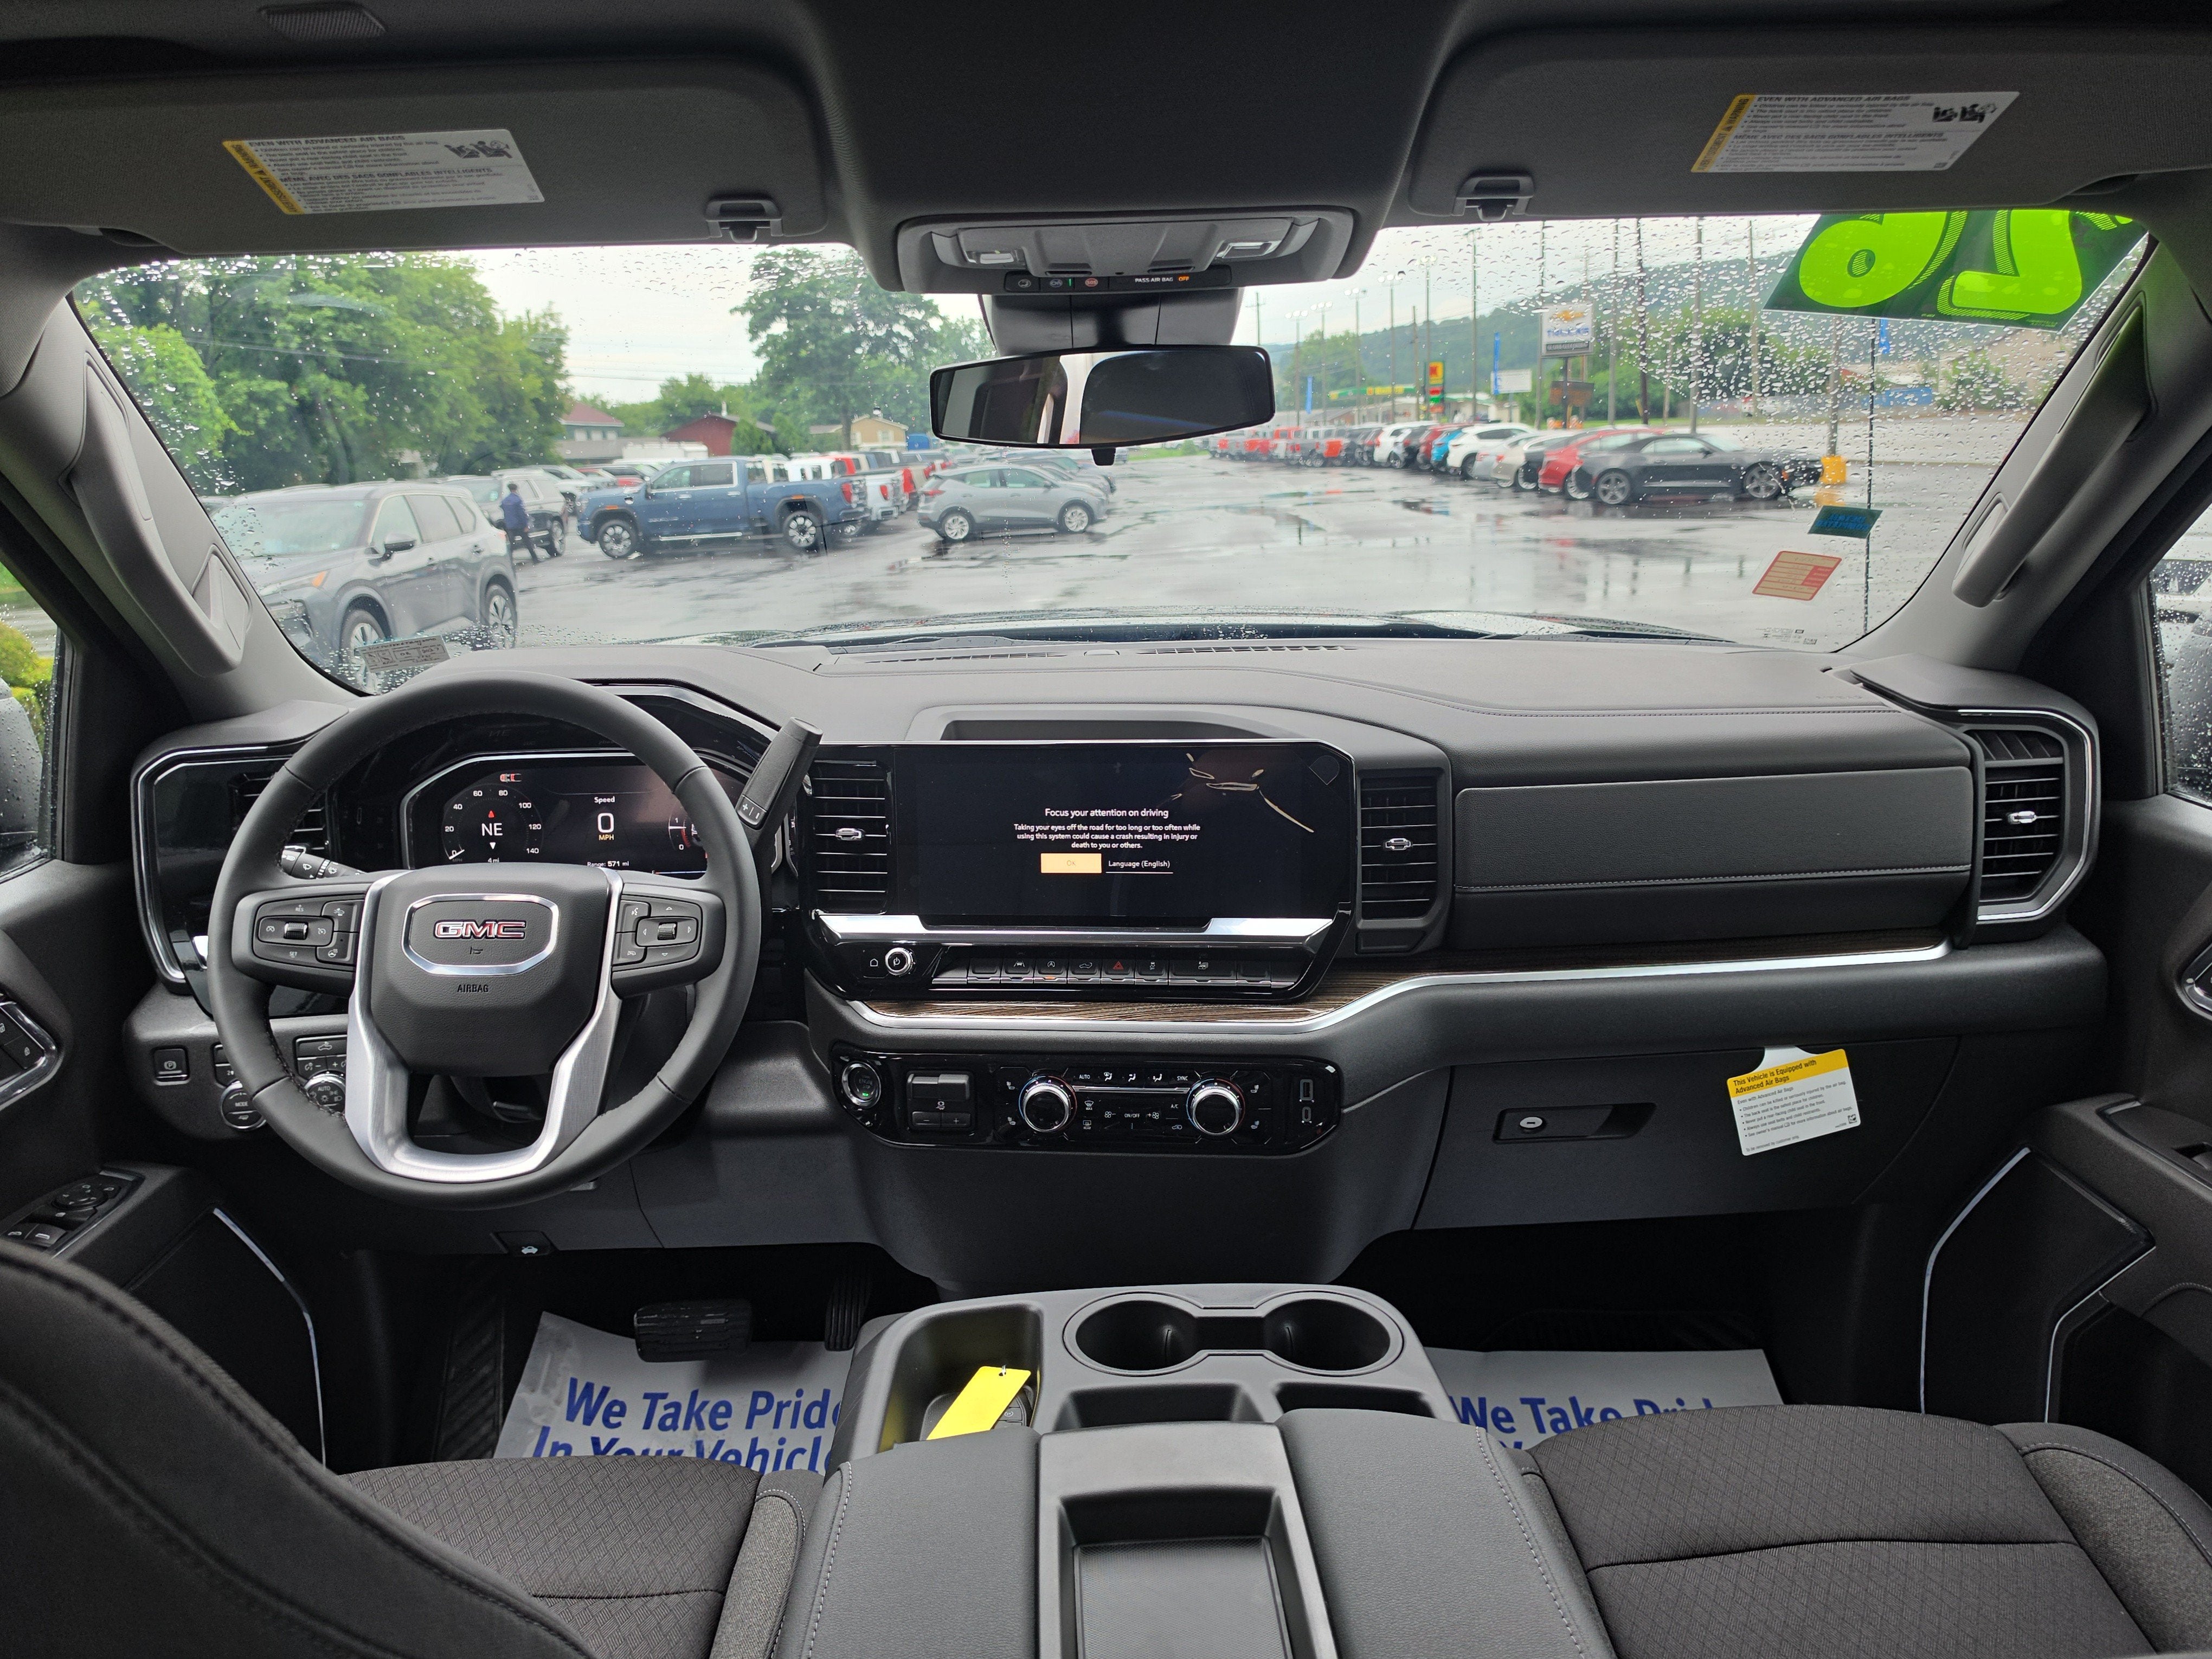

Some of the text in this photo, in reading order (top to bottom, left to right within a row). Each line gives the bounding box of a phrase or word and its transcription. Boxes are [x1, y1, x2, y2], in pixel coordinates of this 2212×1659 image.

[594, 796, 615, 805] Speed
[1045, 808, 1069, 816] Focus
[1070, 810, 1088, 819] your
[1090, 808, 1127, 816] attention
[1140, 808, 1169, 819] driving
[481, 823, 503, 836] NE
[597, 813, 614, 833] 0
[1134, 833, 1162, 841] resulting
[434, 920, 526, 938] GMC
[457, 984, 488, 993] AIRBAG
[1733, 1078, 1745, 1086] This
[1747, 1072, 1768, 1082] Vehicle
[1776, 1063, 1802, 1076] Equipped
[1804, 1059, 1816, 1068] with
[1735, 1082, 1764, 1094] Advanced
[1774, 1075, 1790, 1084] Bags
[565, 1377, 627, 1429] We
[642, 1389, 732, 1432] Take
[1449, 1396, 1515, 1434] We
